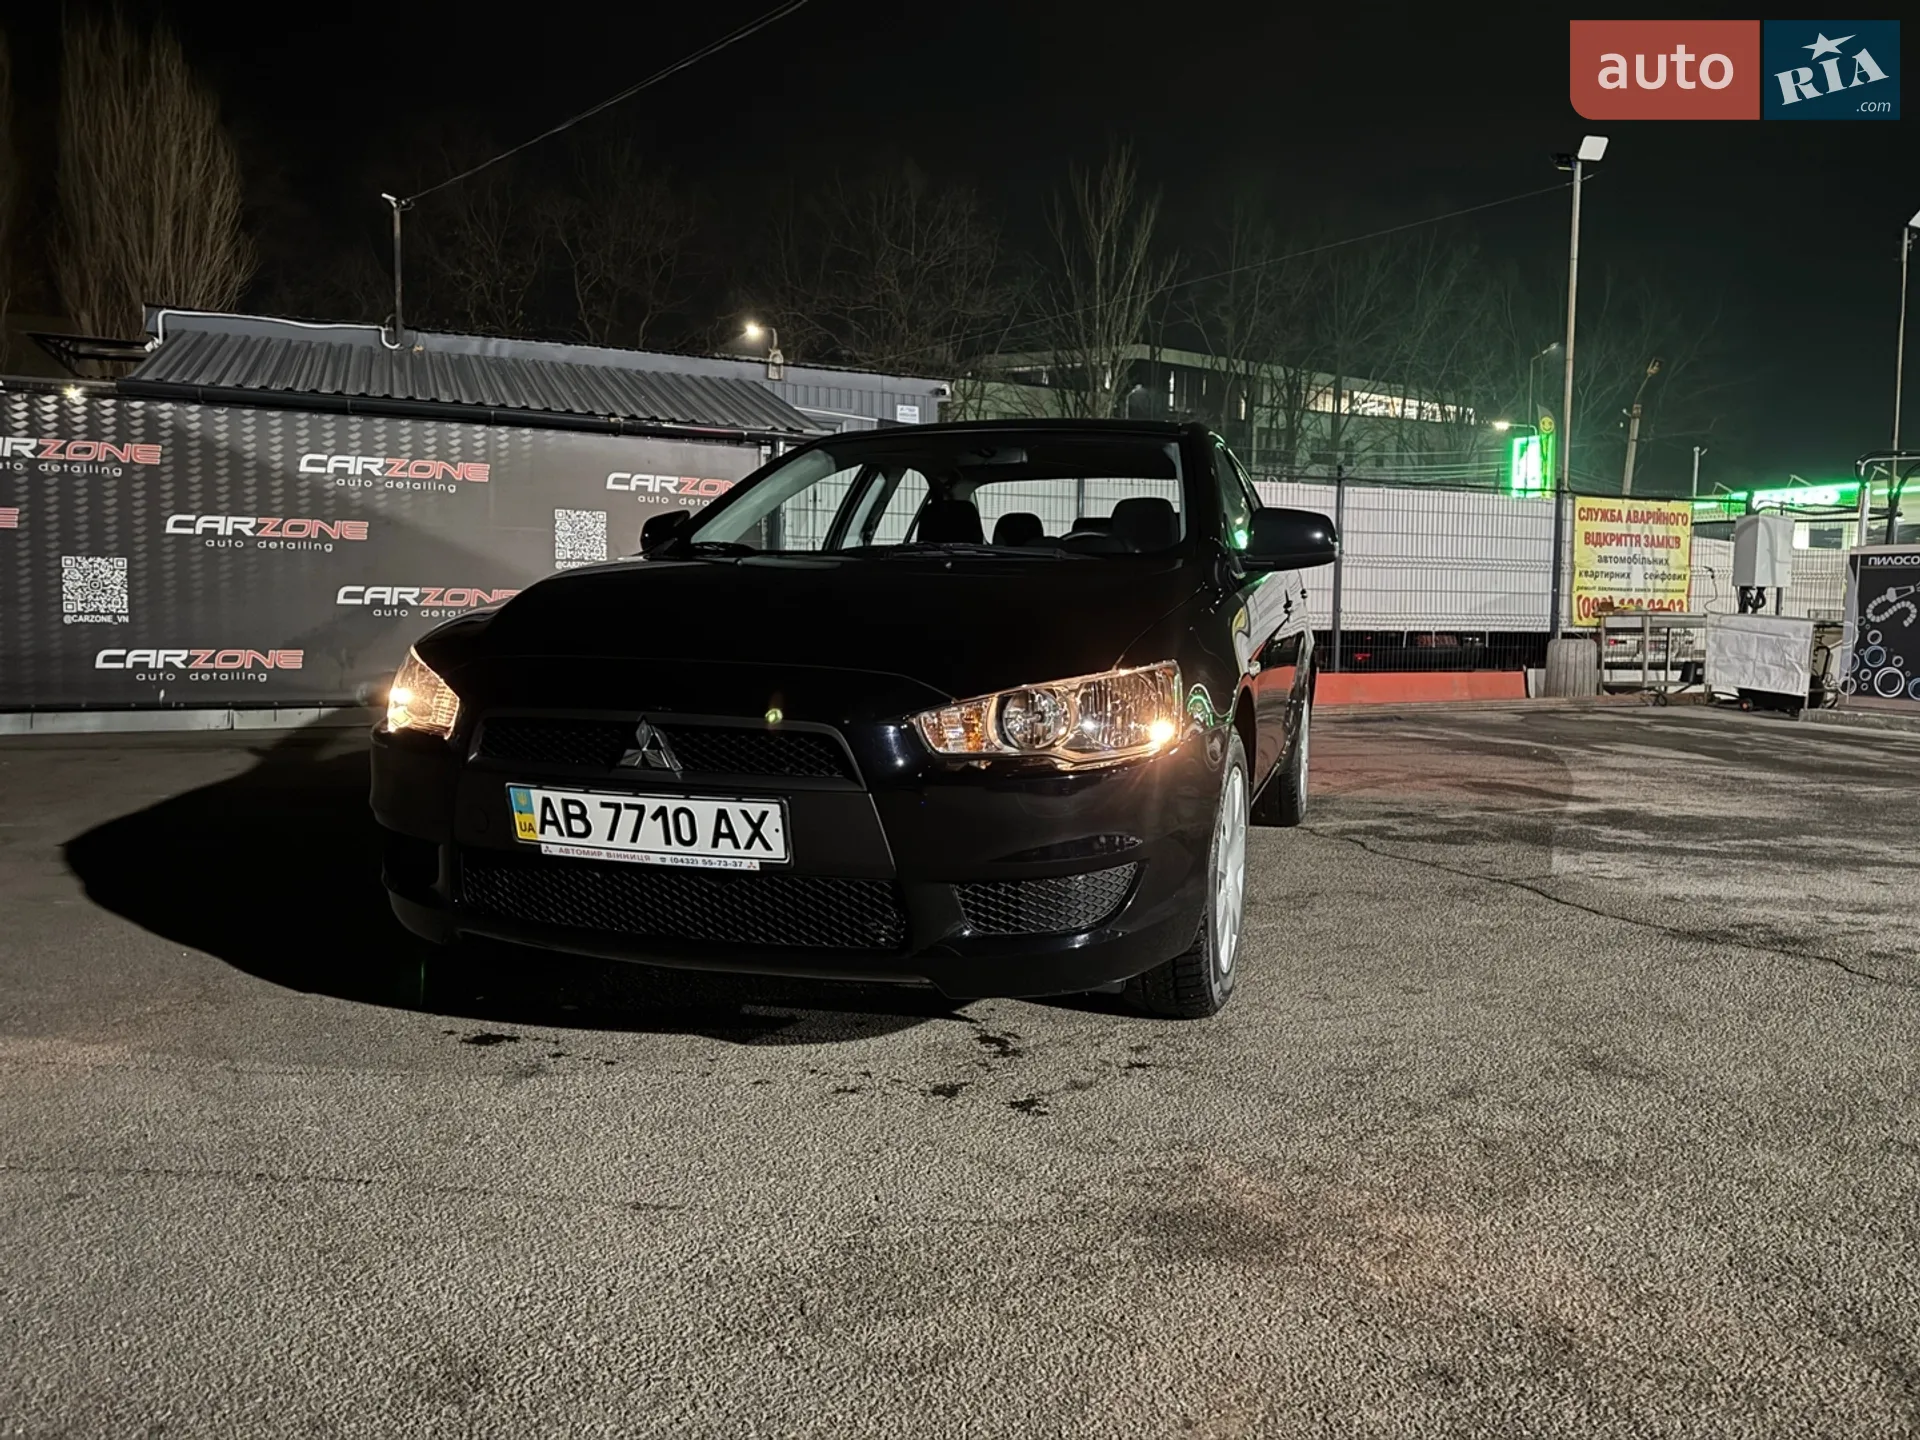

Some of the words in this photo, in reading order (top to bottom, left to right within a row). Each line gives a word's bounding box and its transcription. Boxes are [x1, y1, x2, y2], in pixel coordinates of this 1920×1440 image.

[0, 437, 162, 465] RZONE
[38, 462, 122, 477] detailing
[299, 453, 490, 482] CARZONE
[336, 477, 373, 489] auto
[385, 478, 456, 493] detailing
[638, 495, 669, 504] auto
[1578, 507, 1623, 523] СЛУЖБА
[1626, 508, 1689, 526] АВАРІЙНОГО
[165, 514, 369, 540] CARZONE
[205, 538, 244, 548] auto
[257, 539, 333, 552] detailing
[1584, 531, 1641, 548] ВІДКРИТТЯ
[1643, 534, 1681, 549] ЗАМКІВ
[1597, 554, 1669, 566] автомобільних
[1579, 570, 1632, 581] квартирних
[1643, 572, 1687, 583] сейфових
[63, 615, 129, 624] @CARZONE_VN
[373, 609, 408, 617] auto
[95, 649, 304, 669] CARZONE
[136, 672, 175, 681] auto
[190, 671, 267, 682] detailing
[519, 821, 535, 834] UA
[539, 796, 592, 839] AB
[600, 801, 698, 848] 7710
[711, 808, 773, 851] AX
[558, 847, 603, 858] АВТОМИР
[606, 850, 651, 862] ВІННИЦЯ
[670, 856, 699, 866] (0432)
[702, 858, 743, 868] 55-73-37
